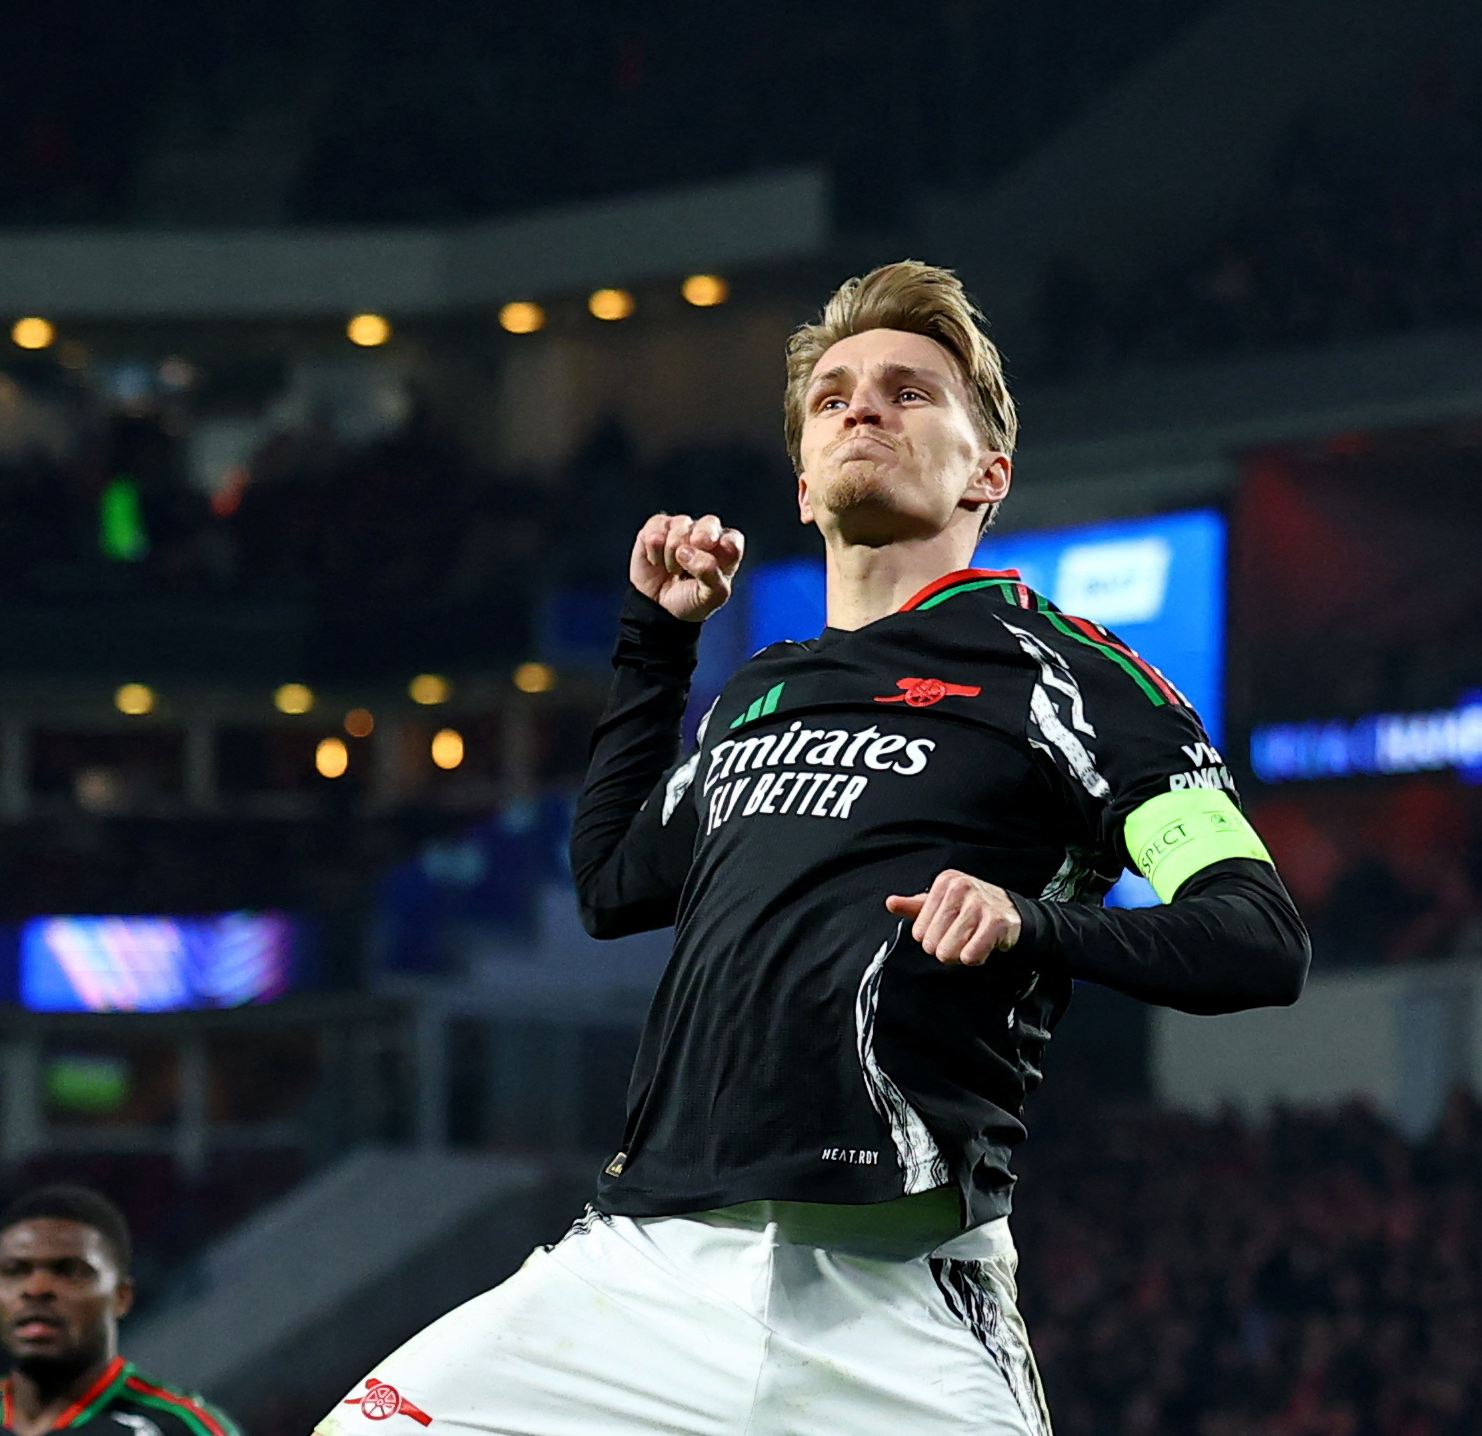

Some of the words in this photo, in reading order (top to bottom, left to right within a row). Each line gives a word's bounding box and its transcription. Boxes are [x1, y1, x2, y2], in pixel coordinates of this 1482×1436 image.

[704, 721, 936, 797] Emirates
[707, 776, 751, 836] FLY
[741, 772, 868, 820] BETTER
[821, 1148, 879, 1165] HEAT.RDY
